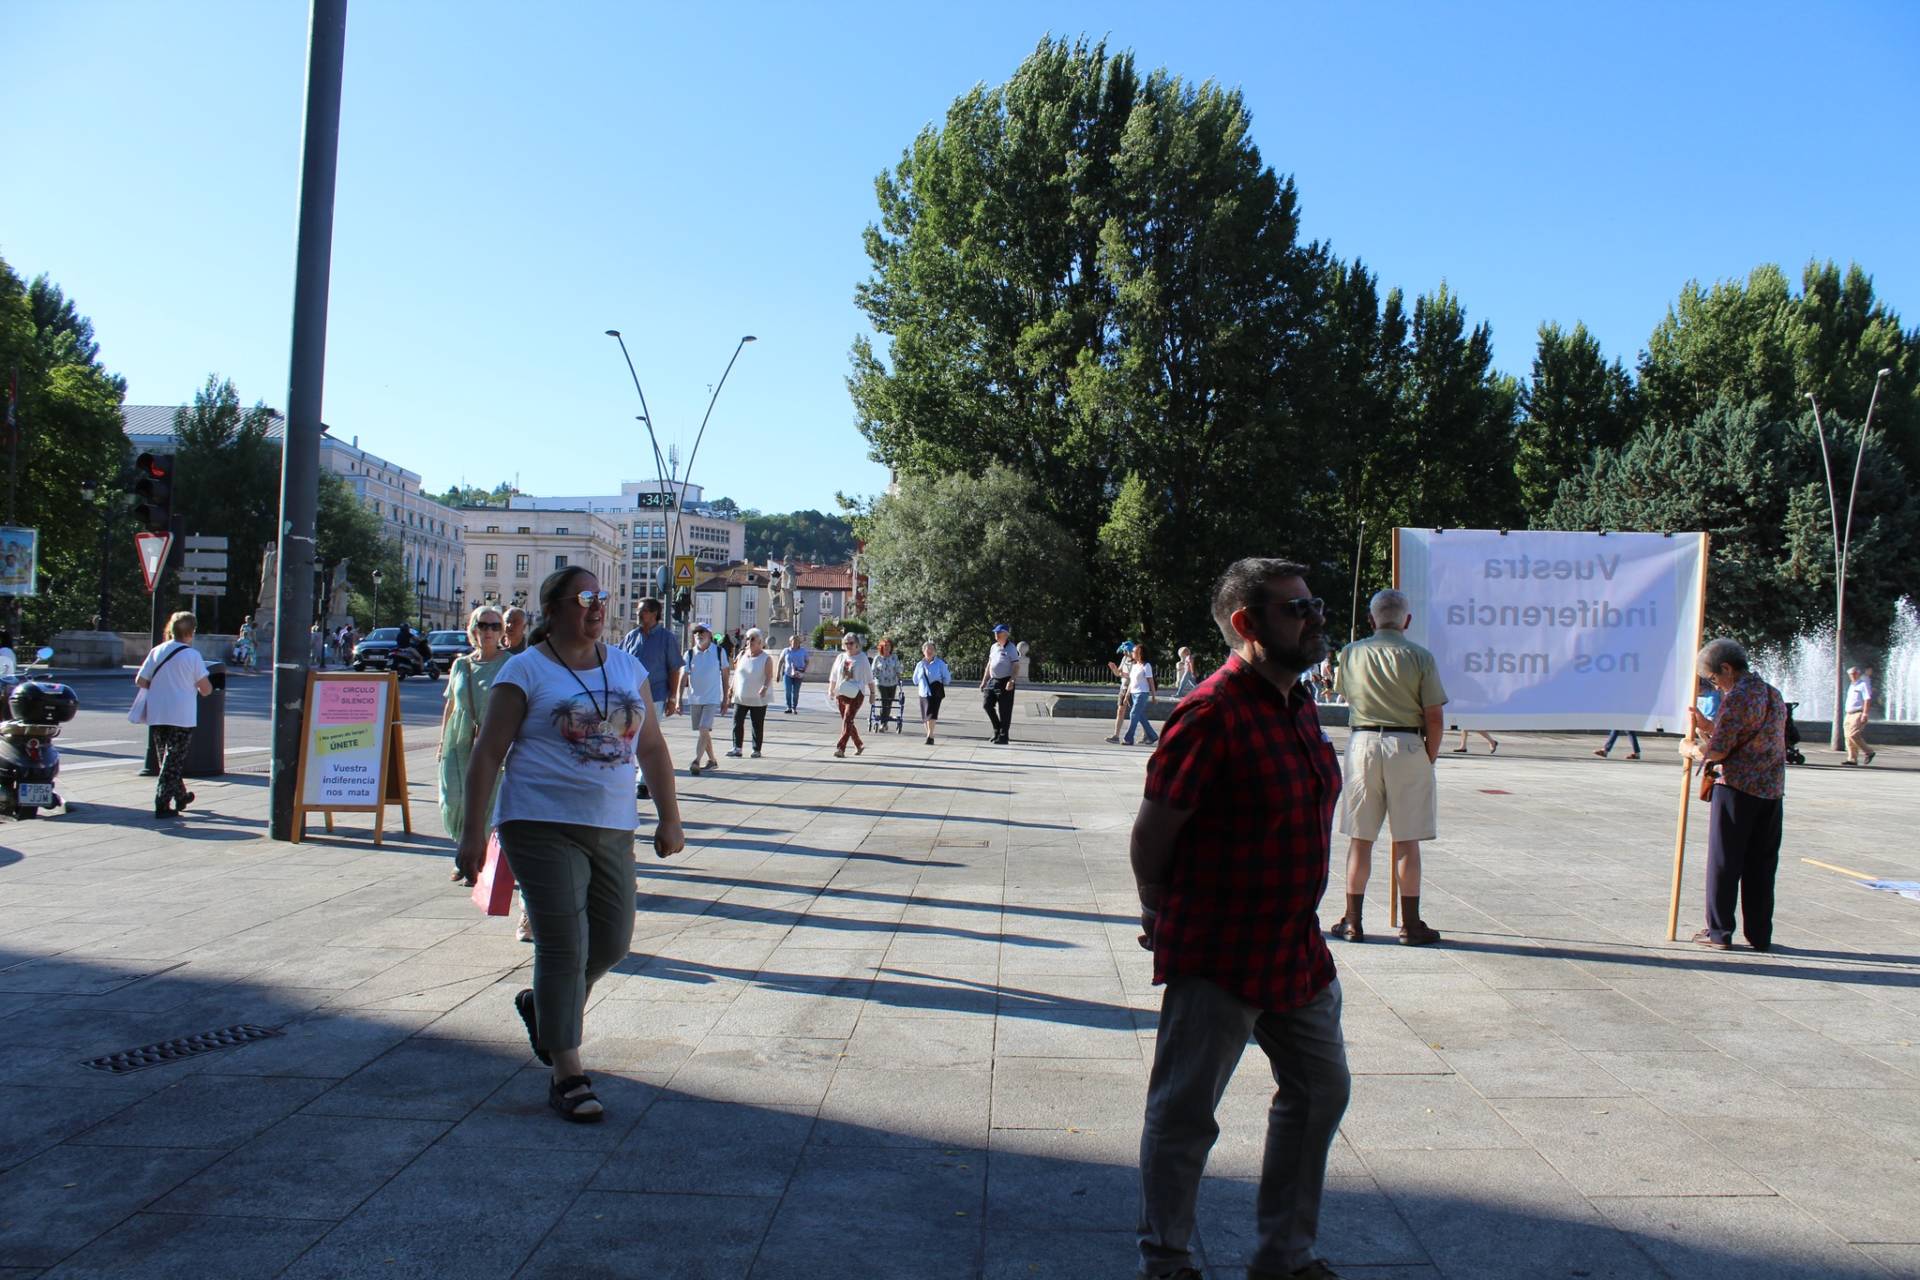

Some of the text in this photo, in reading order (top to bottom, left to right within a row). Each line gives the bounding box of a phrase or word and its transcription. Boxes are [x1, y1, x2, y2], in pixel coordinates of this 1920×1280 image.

[333, 764, 367, 772] Vuestra
[323, 776, 375, 784] indiferencia
[347, 788, 370, 796] mata
